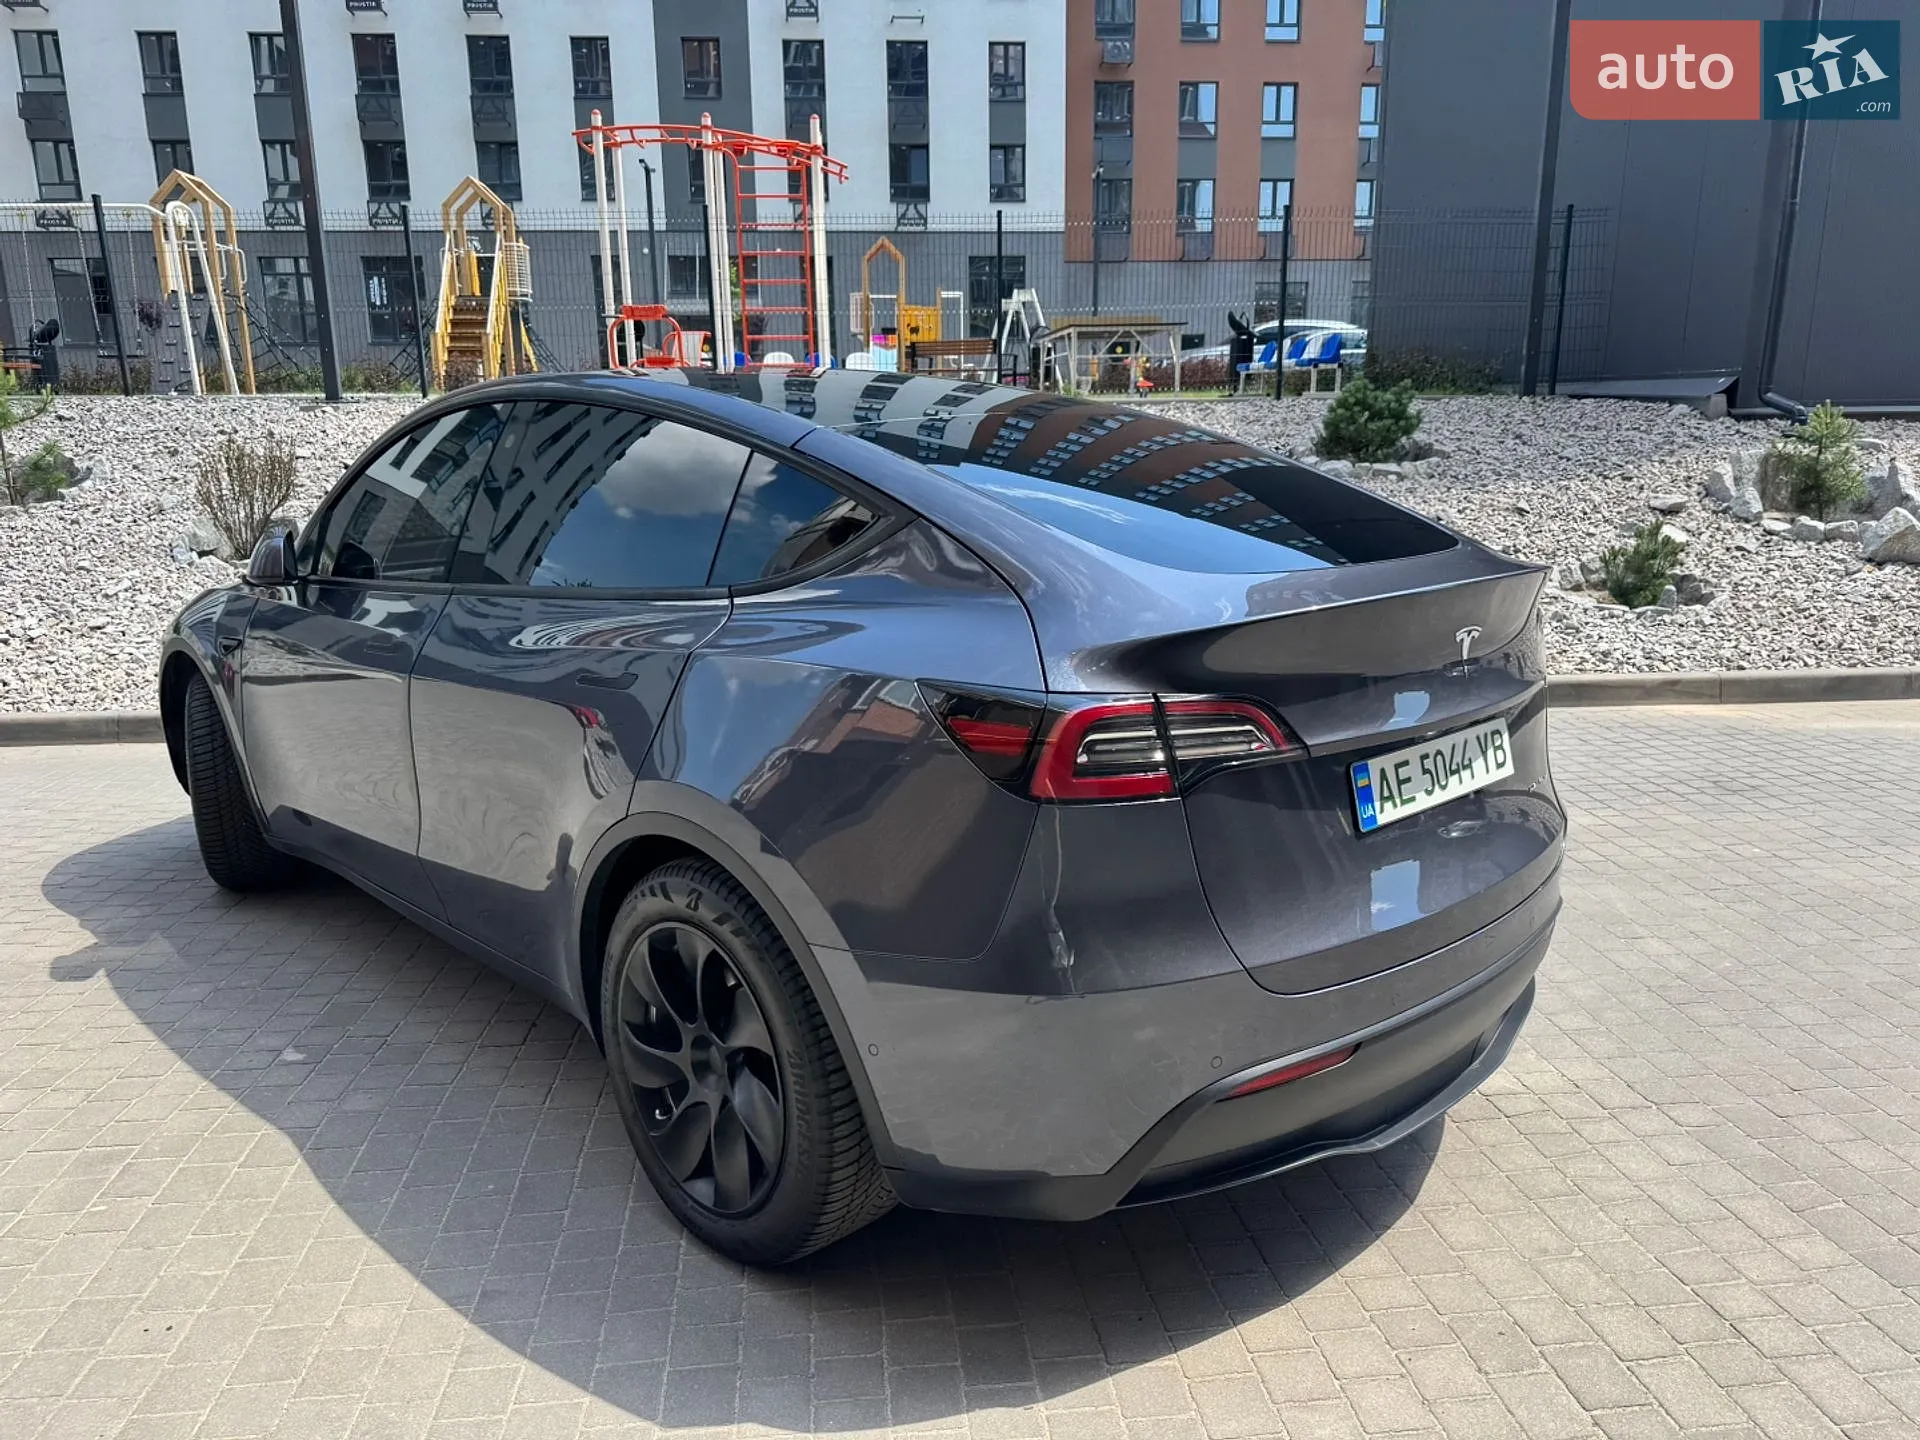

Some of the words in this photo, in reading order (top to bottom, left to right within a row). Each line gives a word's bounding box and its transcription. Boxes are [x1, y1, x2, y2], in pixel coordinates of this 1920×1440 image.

[1379, 760, 1417, 814] AE
[1419, 737, 1475, 797] 5044
[1476, 729, 1507, 775] YB
[1362, 805, 1375, 819] UA
